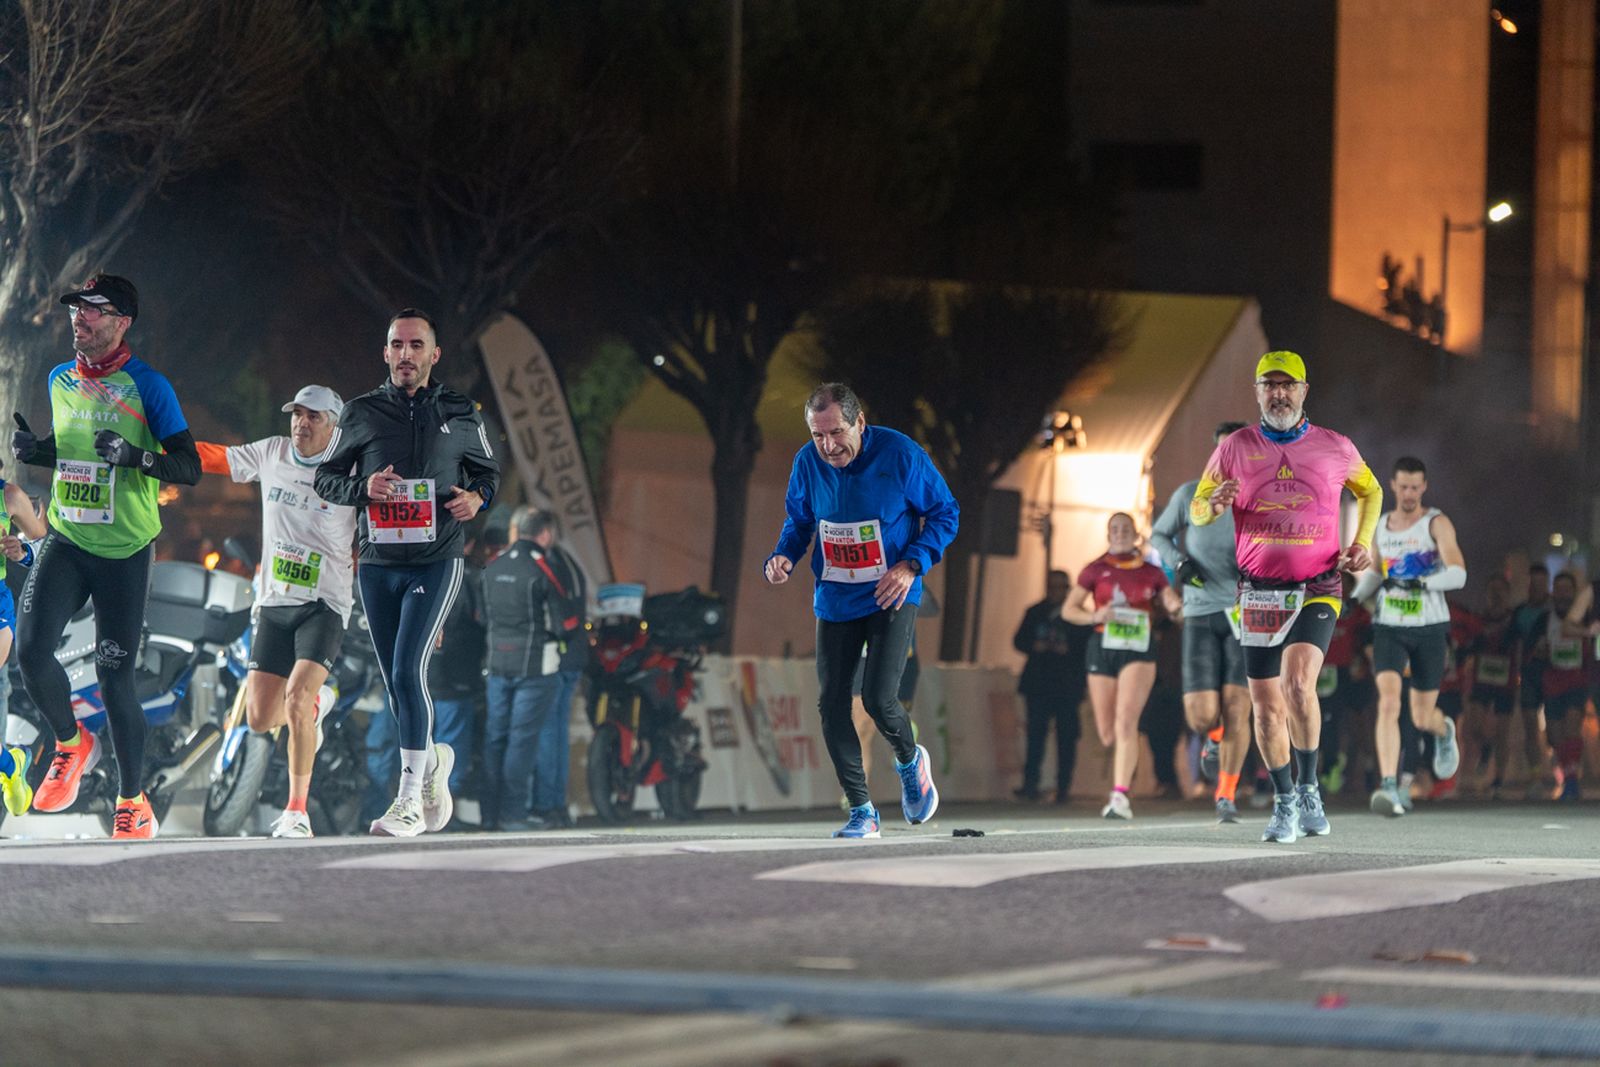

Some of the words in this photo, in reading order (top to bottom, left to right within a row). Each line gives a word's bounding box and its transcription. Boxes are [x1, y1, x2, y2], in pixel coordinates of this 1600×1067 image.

[71, 408, 119, 422] SAKATA
[65, 482, 101, 503] 7920
[1274, 482, 1297, 493] 21K
[379, 502, 421, 522] 9152
[833, 543, 869, 563] 9151
[277, 558, 312, 581] 3456
